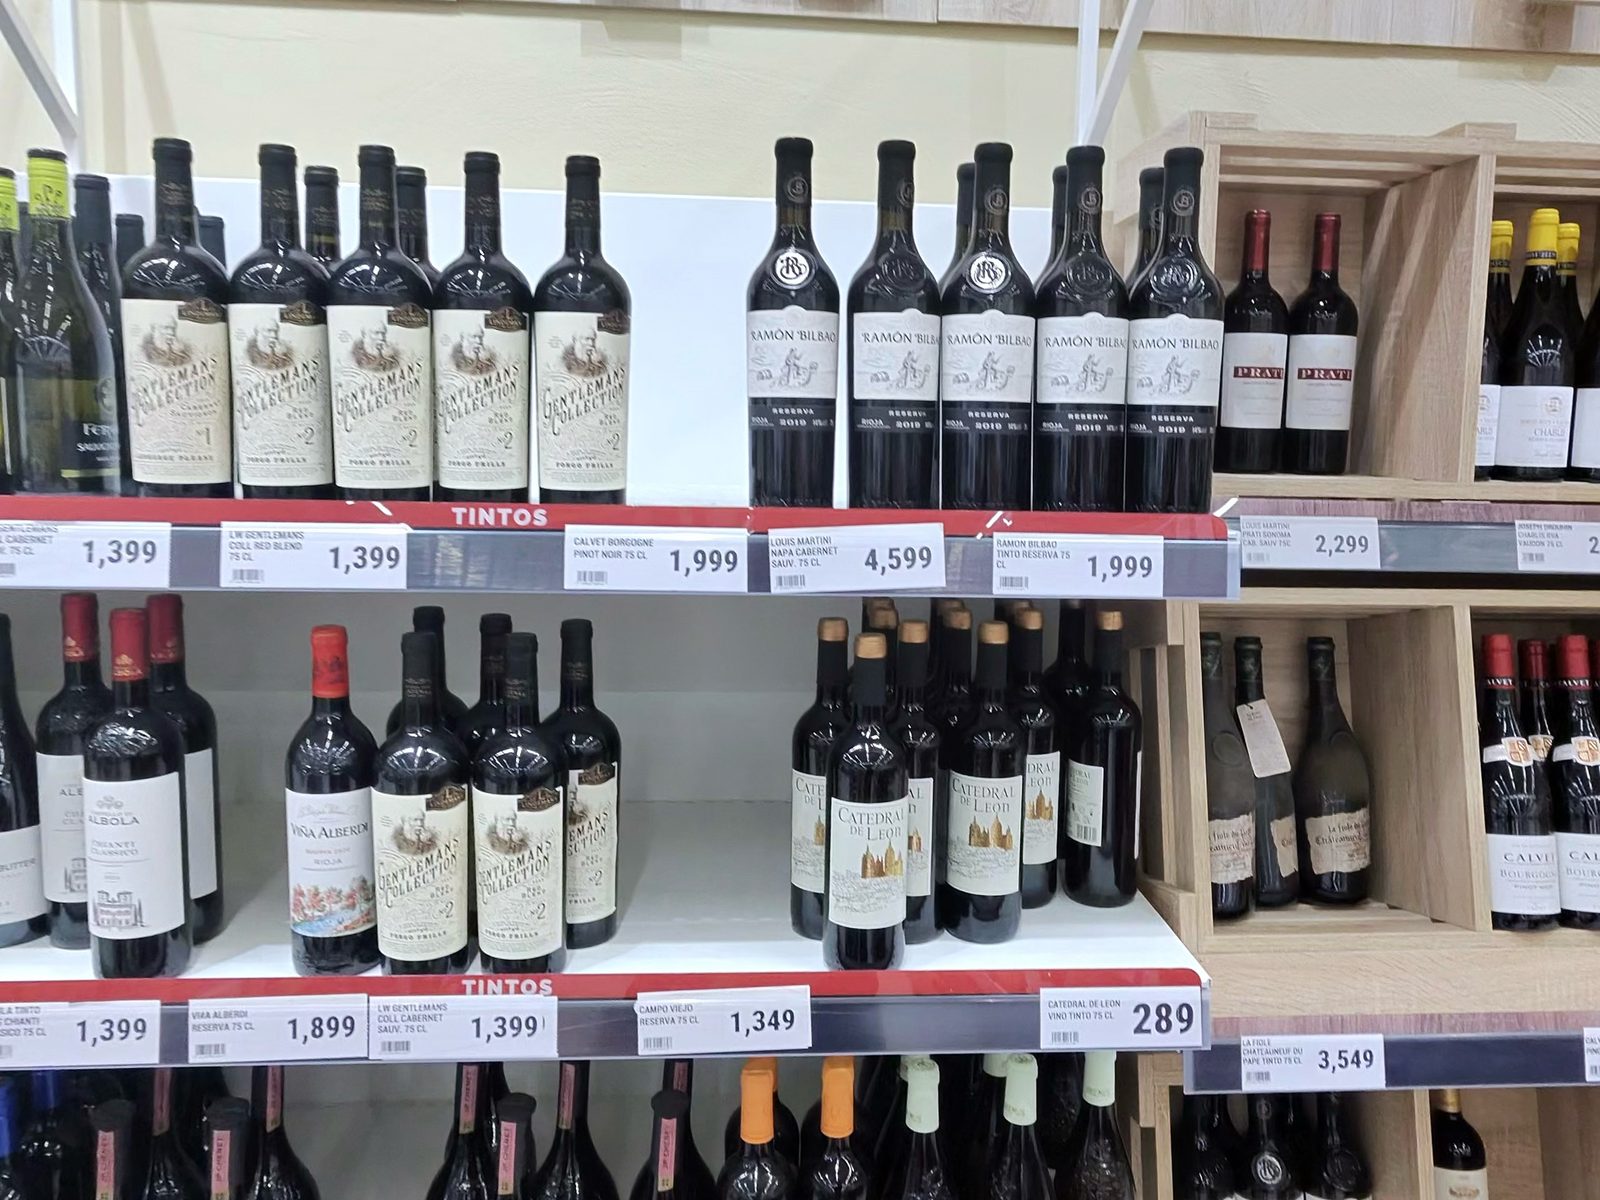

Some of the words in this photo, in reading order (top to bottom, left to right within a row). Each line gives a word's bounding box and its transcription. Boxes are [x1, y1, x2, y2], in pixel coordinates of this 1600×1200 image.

[452, 508, 547, 527] TINTOS
[574, 537, 606, 546] CALVET
[608, 538, 654, 547] BORGOGNE
[770, 537, 796, 547] LOUIS
[797, 535, 832, 545] MARTINI
[996, 539, 1026, 548] RAMON
[1028, 540, 1057, 549] BILBAO
[1315, 534, 1369, 557] 2,299
[83, 540, 157, 569] 1,399
[574, 550, 599, 559] PINOT
[601, 550, 622, 559] NOIR
[625, 550, 635, 559] 75
[637, 551, 648, 560] CL
[771, 547, 794, 557] NAPA
[795, 546, 838, 556] CABERNET
[996, 550, 1021, 558] TINTO
[1022, 551, 1059, 559] RESERVA
[1060, 551, 1071, 560] 75
[329, 546, 401, 575] 1,399
[670, 549, 738, 577] 1,999
[772, 559, 797, 568] SAUV.
[799, 559, 809, 567] 75
[810, 558, 822, 567] CL
[865, 546, 932, 576] 4,599
[996, 560, 1007, 569] CL
[1087, 555, 1153, 583] 1,999
[952, 778, 1015, 798] CATEDRAL
[960, 796, 971, 806] DE
[850, 825, 863, 836] DE
[461, 979, 553, 996] TINTOS
[378, 1004, 391, 1012] LW
[392, 1003, 448, 1012] GENTLEMANS
[639, 1005, 668, 1014] CAMPO
[670, 1004, 694, 1013] VIEJO
[1048, 1000, 1087, 1008] CATEDRAL
[1089, 1000, 1099, 1008] DE
[1100, 999, 1121, 1008] LEON
[378, 1015, 399, 1023] COLL
[401, 1014, 443, 1023] CABERNET
[639, 1017, 678, 1026] RESERVA
[678, 1016, 688, 1025] 75
[689, 1016, 700, 1024] CL
[1048, 1012, 1067, 1020] VINO
[1069, 1012, 1091, 1020] TINTO
[1093, 1012, 1103, 1020] 75
[1104, 1011, 1115, 1020] CL
[1133, 1002, 1194, 1035] 289
[192, 1022, 230, 1032] RESERVA
[232, 1022, 242, 1031] 75
[244, 1022, 255, 1031] CL
[417, 1025, 428, 1033] CL
[731, 1009, 795, 1038] 1,349
[76, 1018, 147, 1047] 1,399
[288, 1015, 355, 1045] 1,899
[471, 1015, 538, 1044] 1,399
[1242, 1039, 1252, 1047] LA
[1262, 1057, 1282, 1065] TINTO
[1318, 1049, 1374, 1074] 3,549
